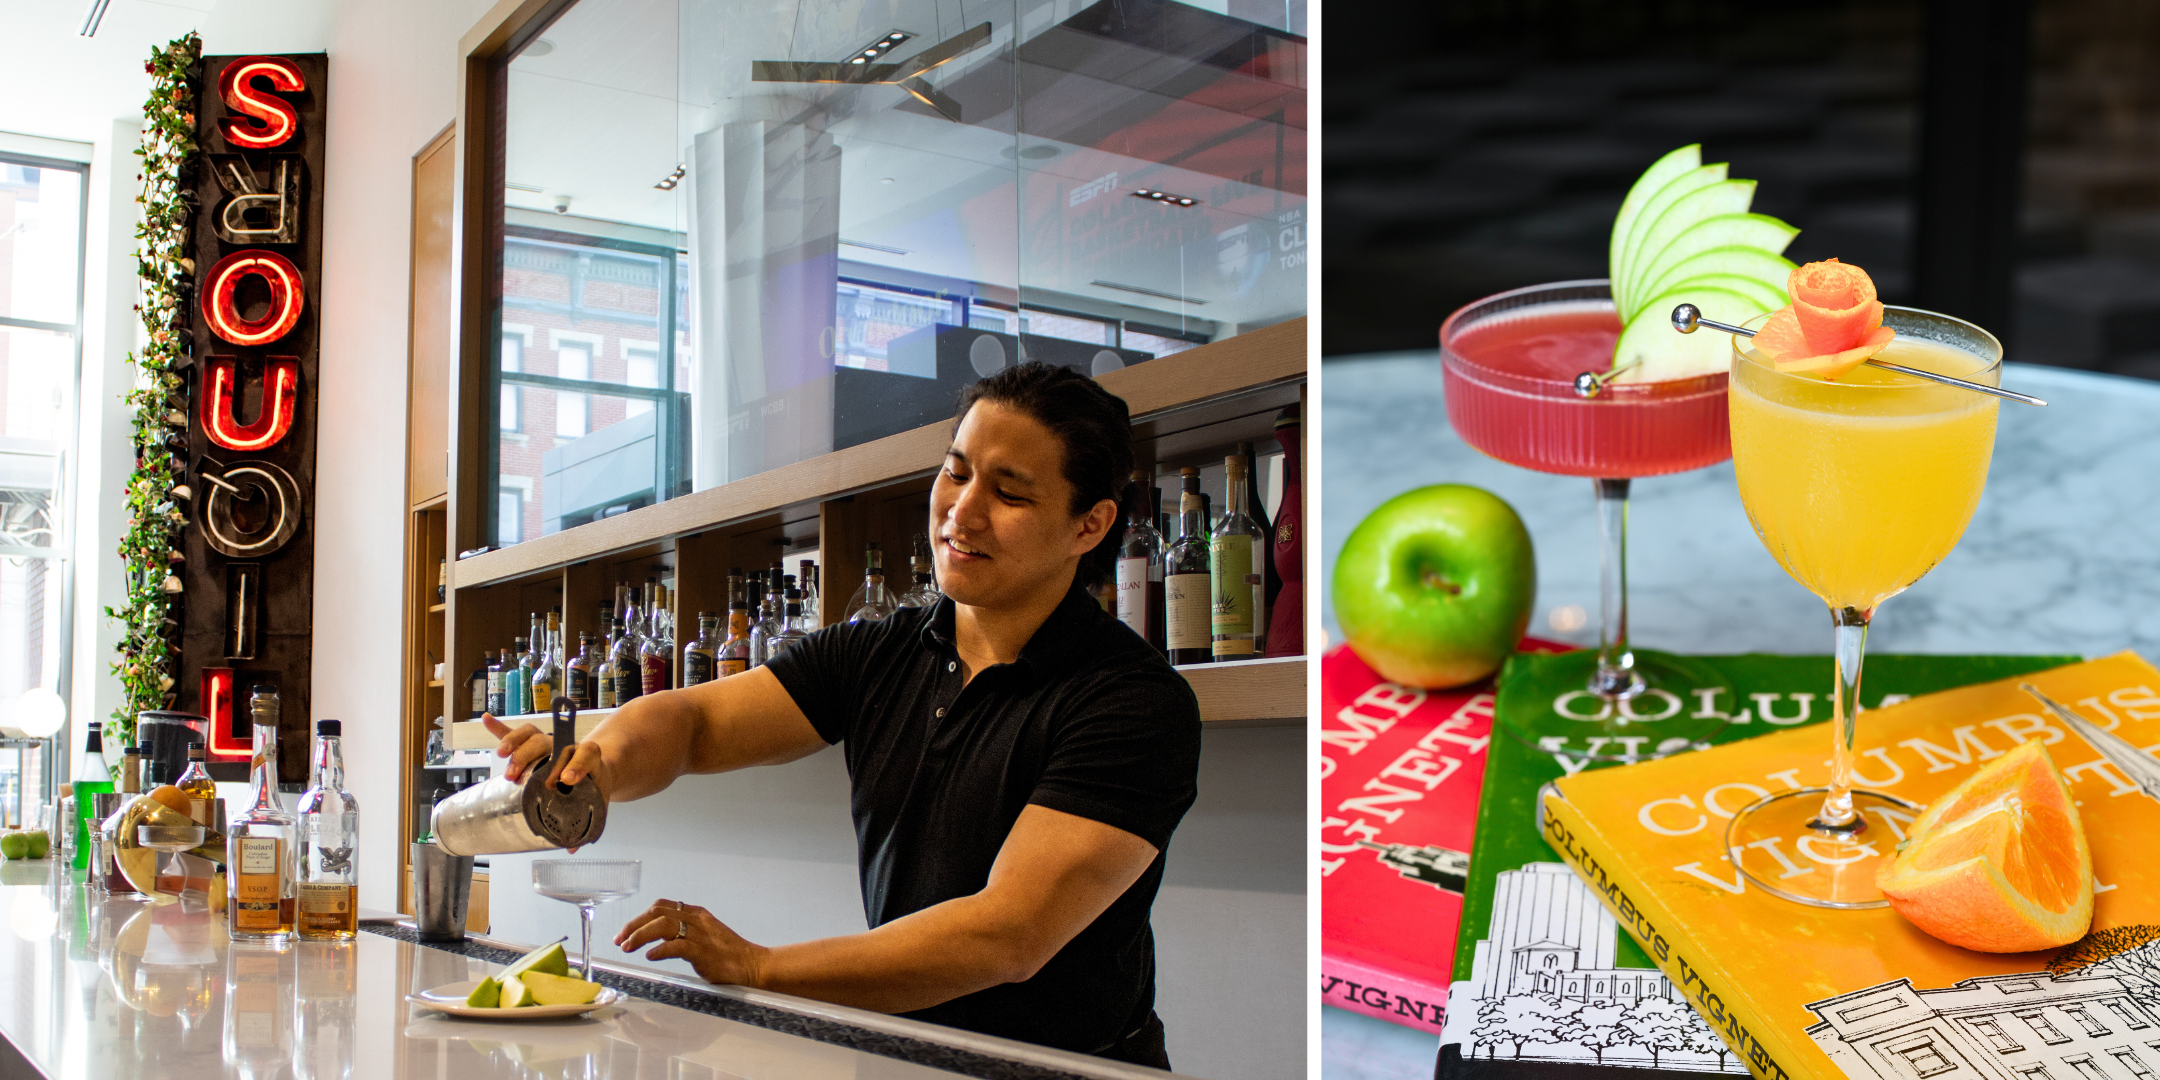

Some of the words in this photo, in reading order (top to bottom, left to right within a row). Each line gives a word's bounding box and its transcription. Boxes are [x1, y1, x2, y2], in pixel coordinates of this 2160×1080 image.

[1069, 171, 1117, 207] ESPN
[1279, 209, 1300, 224] NBA
[1279, 223, 1307, 252] CL
[1279, 250, 1307, 270] TON
[243, 843, 273, 851] Boulard
[1544, 804, 1670, 963] COLUMBUS
